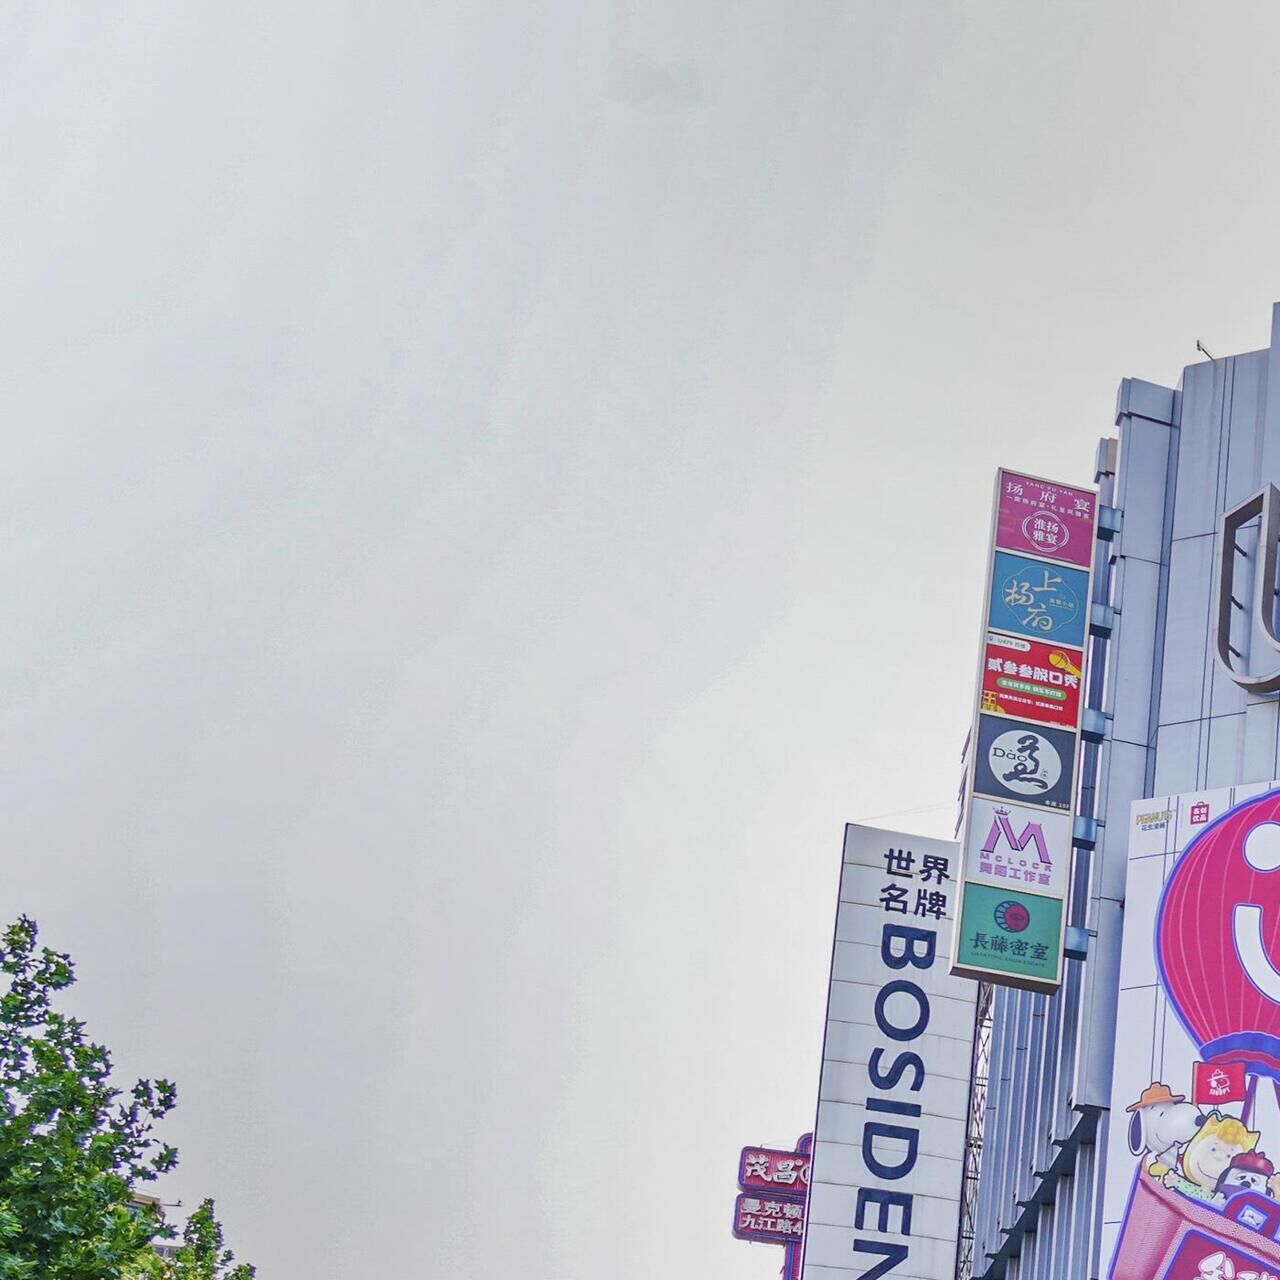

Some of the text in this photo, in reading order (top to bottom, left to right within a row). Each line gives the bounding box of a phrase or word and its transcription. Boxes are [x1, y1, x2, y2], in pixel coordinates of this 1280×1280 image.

[1006, 482, 1090, 512] 扬府宴
[883, 848, 950, 885] 世界
[879, 882, 948, 921] 名牌
[746, 1154, 797, 1184] 茂昌
